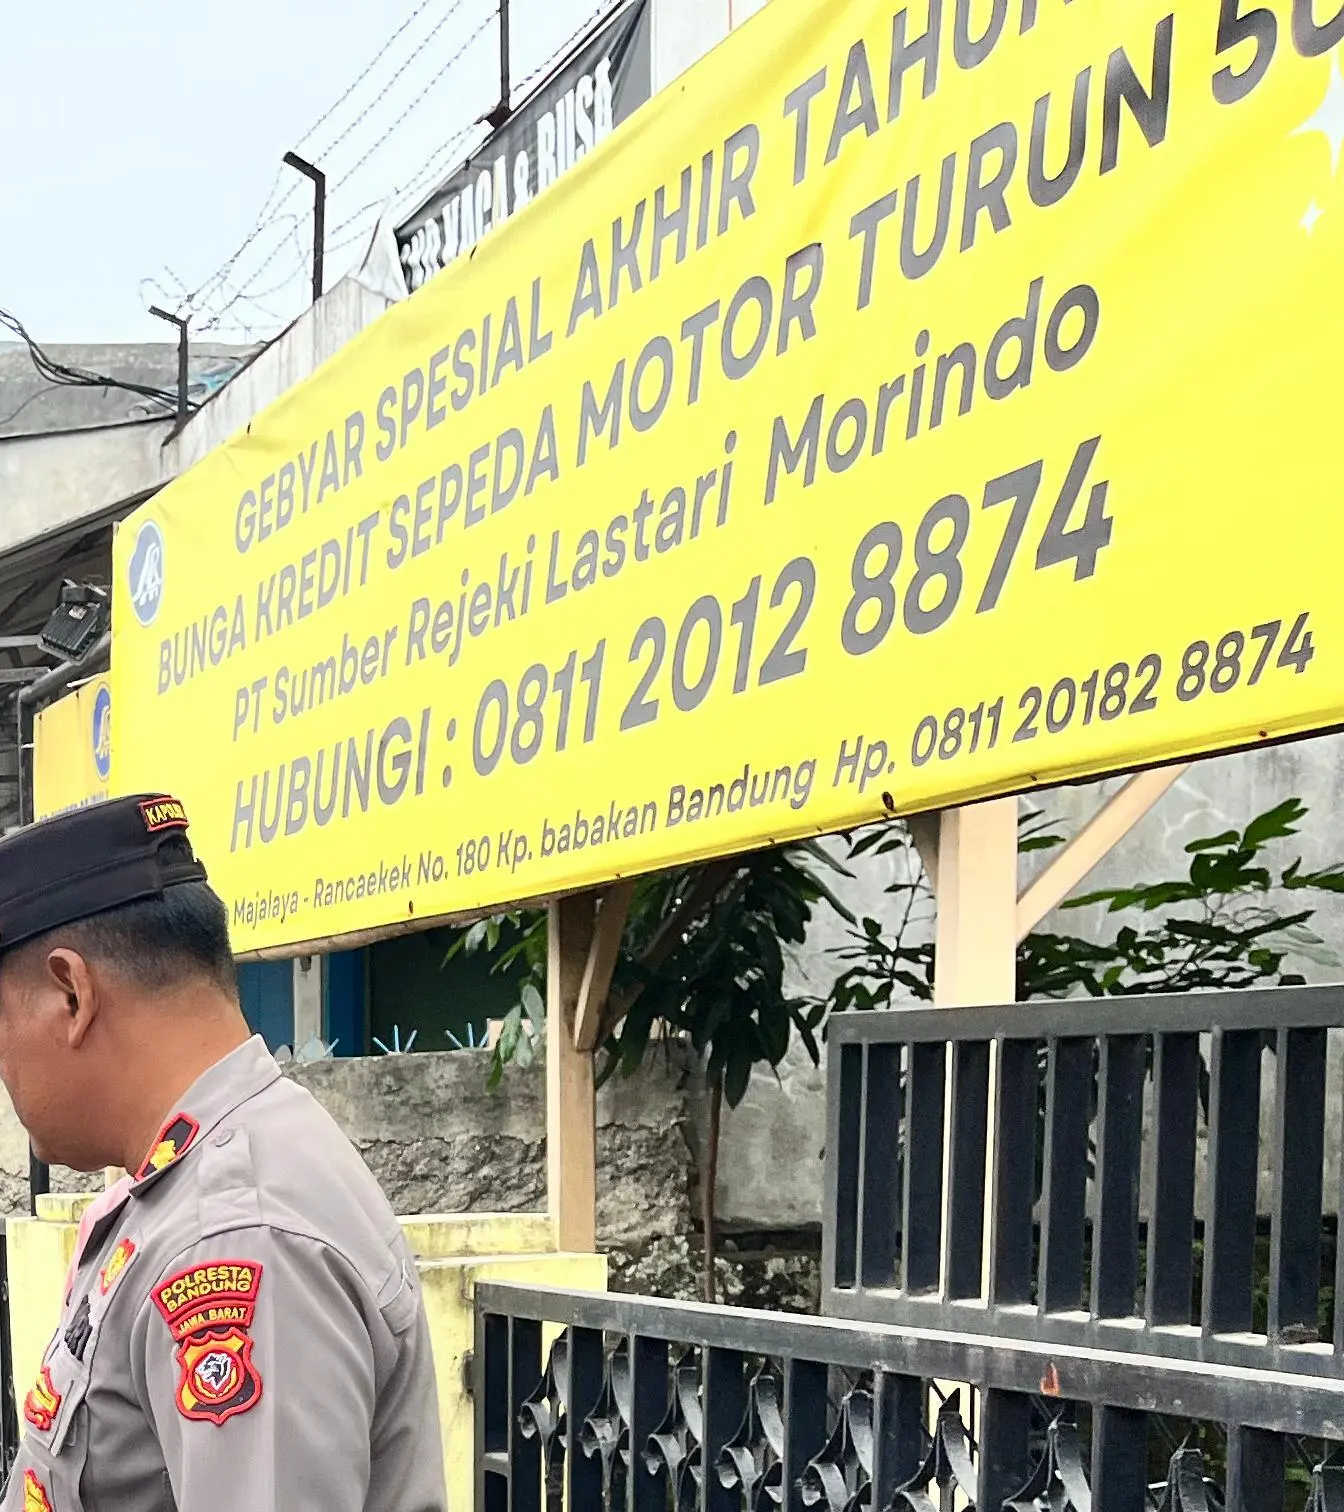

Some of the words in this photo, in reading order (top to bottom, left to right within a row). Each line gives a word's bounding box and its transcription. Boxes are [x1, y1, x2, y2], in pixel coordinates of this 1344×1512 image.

[156, 596, 247, 695] BUNGA
[255, 511, 382, 643] KREDIT
[386, 407, 560, 571] SEPEDA
[577, 243, 825, 468] MOTOR
[849, 12, 1174, 311] TURUN
[233, 675, 269, 742] PT
[273, 624, 399, 727] Sumber
[405, 535, 537, 667] Rejeki
[545, 432, 738, 605] Lastari
[764, 277, 1101, 505] Morindo
[235, 411, 365, 554] GEBYAR
[375, 279, 554, 463] SPESIAL
[566, 123, 762, 337] AKHIR
[229, 706, 433, 853] HUBUNGI
[473, 640, 607, 778] 0811
[620, 557, 817, 733] 2012
[841, 436, 1114, 656] 8874
[233, 891, 299, 931] Majalaya
[313, 854, 411, 909] Rancaekek
[417, 849, 448, 886] No.
[456, 836, 490, 877] 180
[497, 829, 533, 875] Kp.
[539, 800, 657, 858] babakan
[664, 758, 818, 828] Bandung
[834, 734, 896, 791] Hp.
[911, 698, 1005, 768] 0811
[1013, 653, 1163, 743] 20182
[1176, 611, 1314, 703] 8874
[160, 1265, 253, 1304] POLRESTA
[166, 1278, 252, 1313] BANDUNG
[176, 1310, 207, 1334] JAWA
[209, 1305, 247, 1323] BARAT
